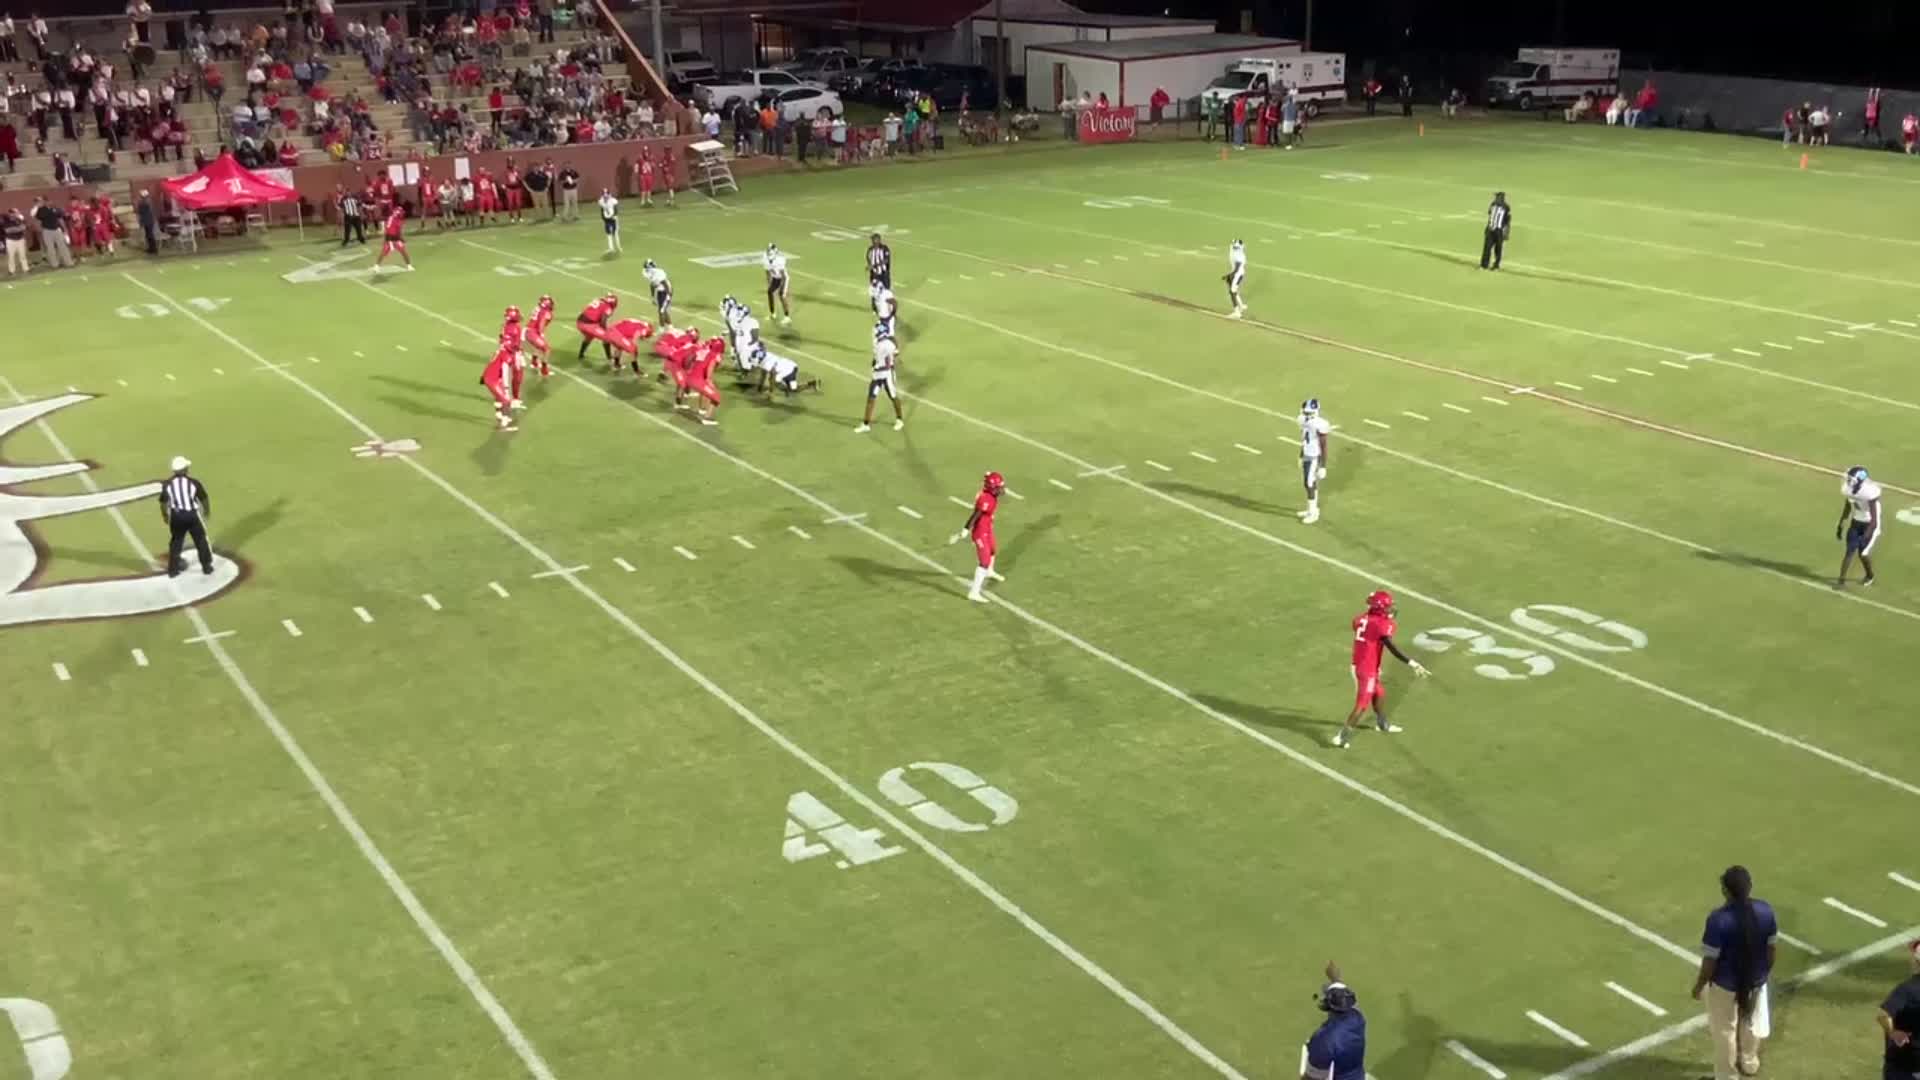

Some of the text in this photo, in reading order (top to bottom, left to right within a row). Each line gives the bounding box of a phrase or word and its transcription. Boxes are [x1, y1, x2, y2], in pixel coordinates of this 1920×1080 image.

[1081, 110, 1135, 137] Victory
[1356, 618, 1369, 642] 2
[1411, 603, 1649, 681] 30
[781, 760, 1020, 870] 40
